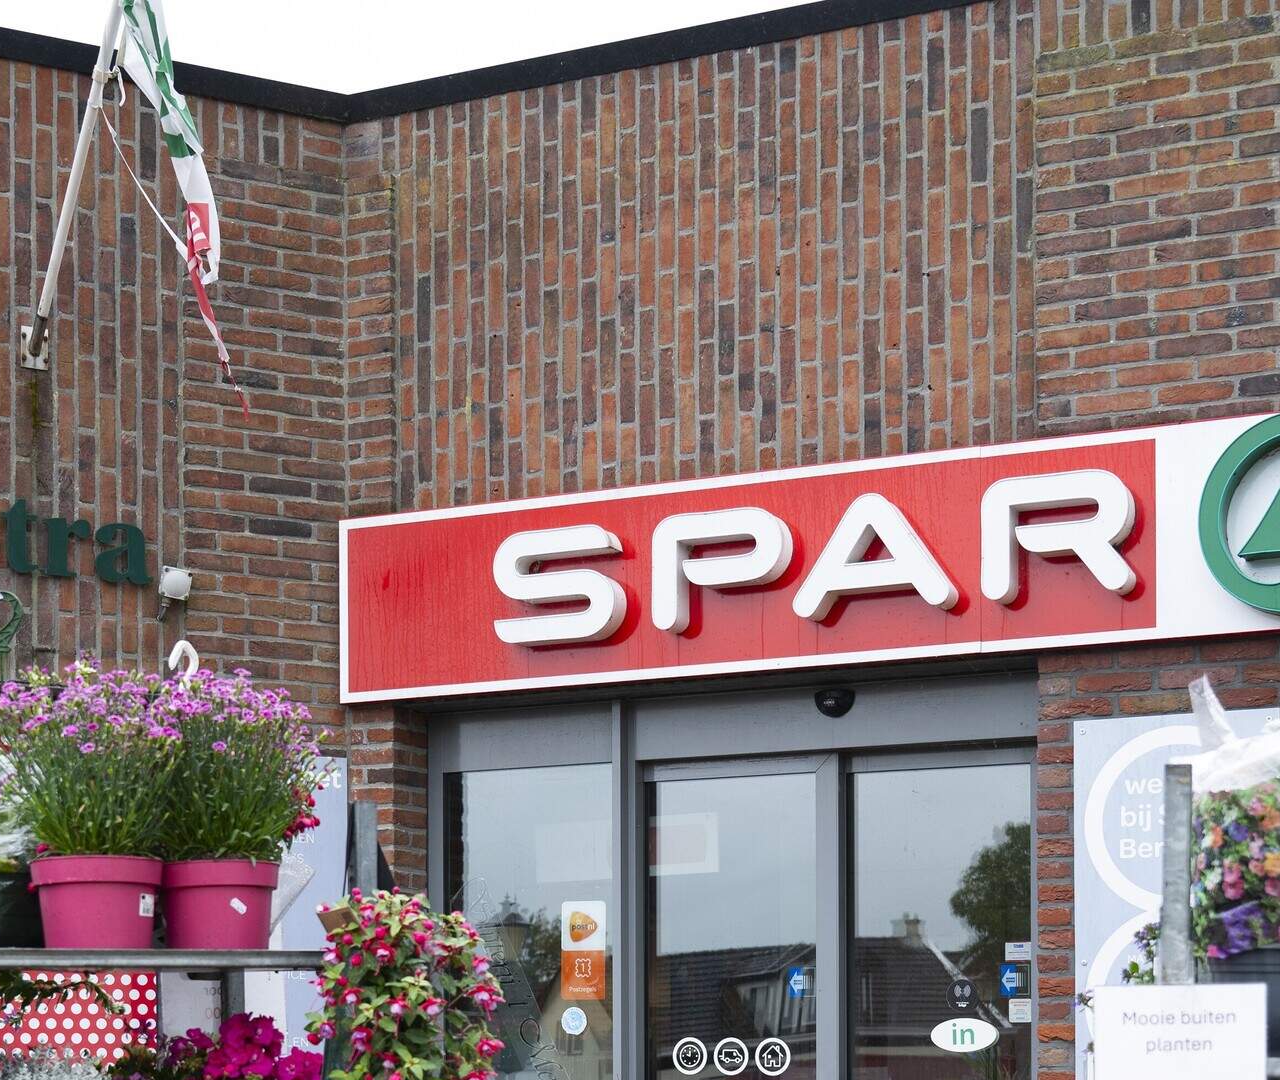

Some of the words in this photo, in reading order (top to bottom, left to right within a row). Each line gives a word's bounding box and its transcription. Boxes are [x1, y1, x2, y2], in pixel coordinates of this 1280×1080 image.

[493, 468, 1136, 646] SPAR
[1120, 805, 1152, 831] bij
[1122, 1012, 1175, 1025] Mooie
[1180, 1010, 1237, 1025] buiten
[952, 1022, 975, 1045] in
[1145, 1038, 1213, 1054] planten
